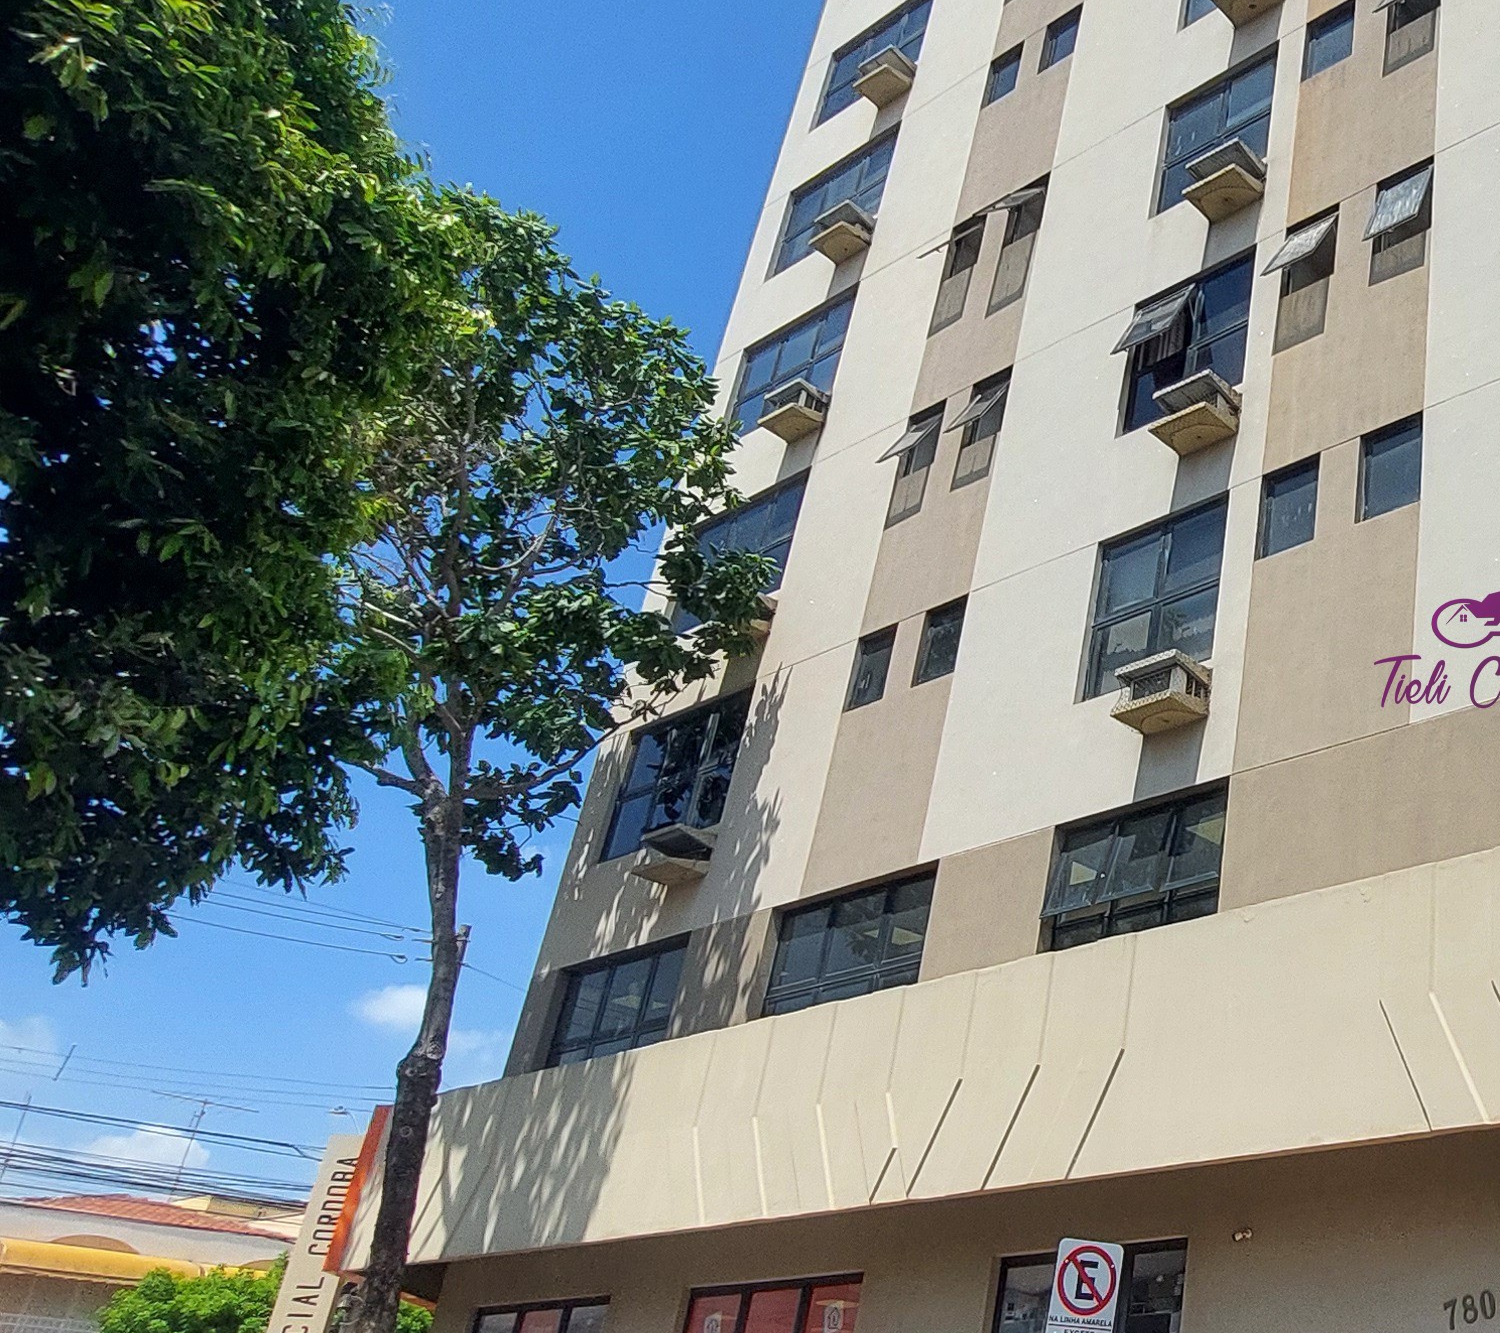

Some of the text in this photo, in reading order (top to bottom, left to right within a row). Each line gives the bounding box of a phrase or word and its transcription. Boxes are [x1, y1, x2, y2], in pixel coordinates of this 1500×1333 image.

[308, 1156, 360, 1256] CORDOBA
[1049, 1315, 1112, 1327] NA LINHA AMARELA
[1443, 1290, 1496, 1331] 780
